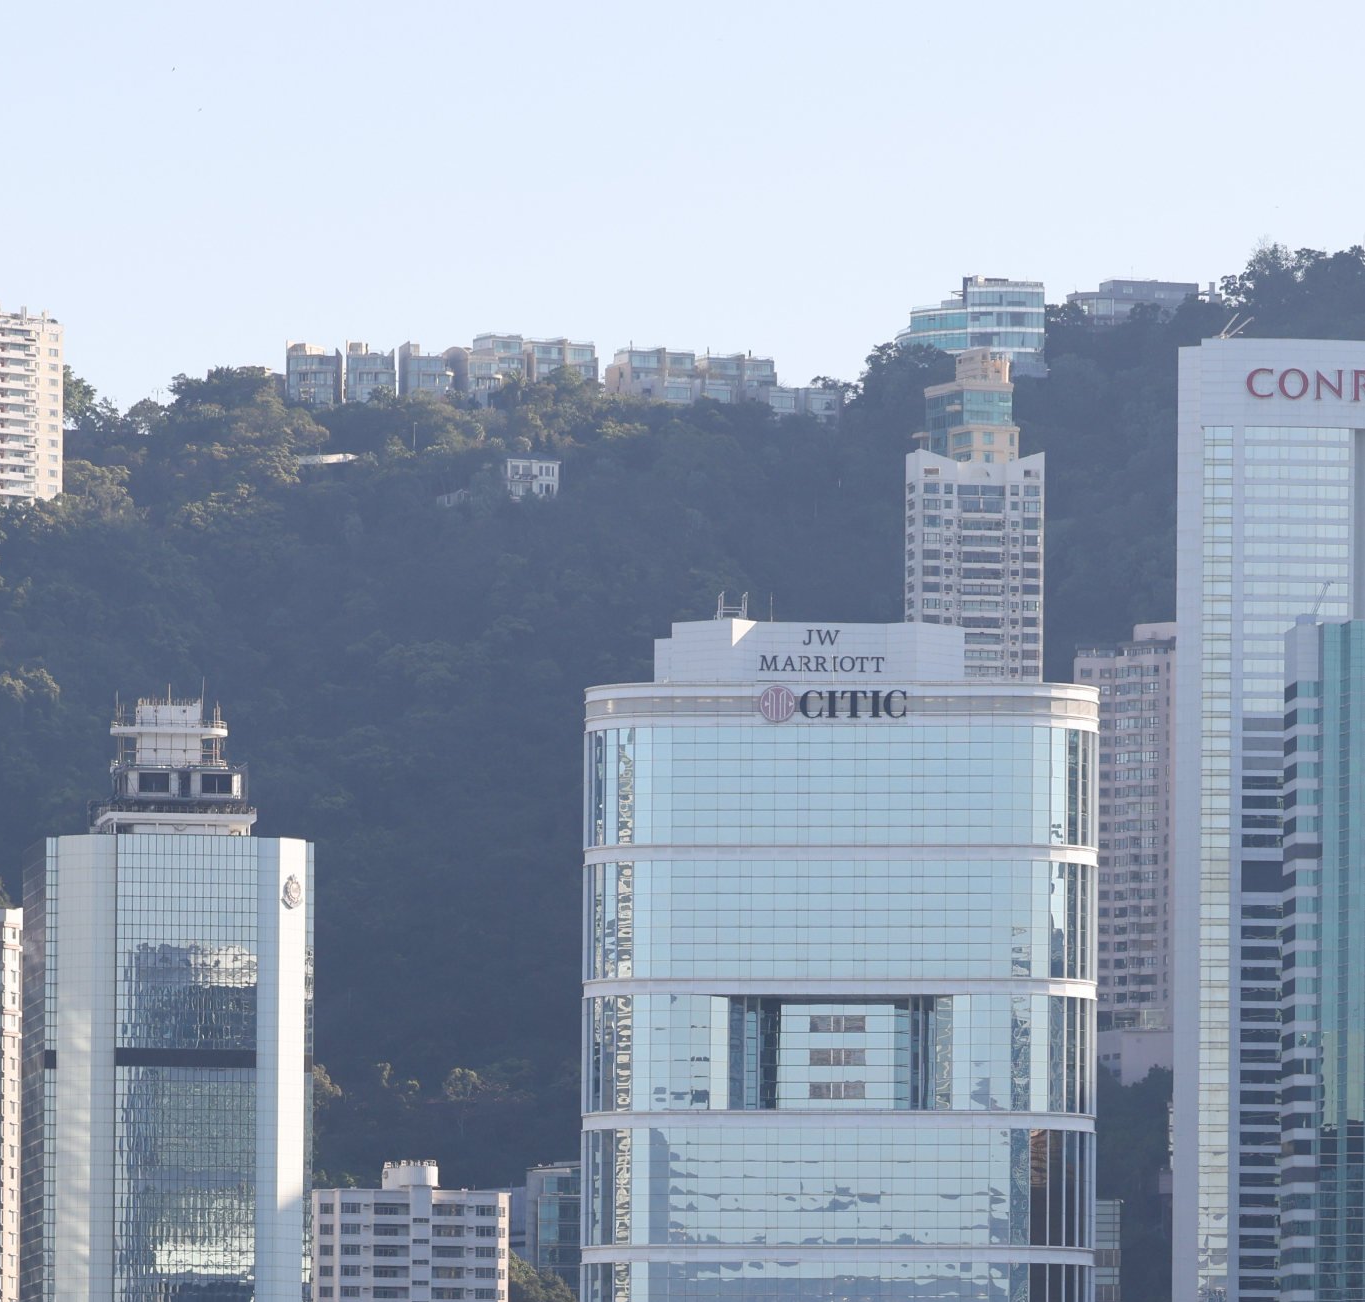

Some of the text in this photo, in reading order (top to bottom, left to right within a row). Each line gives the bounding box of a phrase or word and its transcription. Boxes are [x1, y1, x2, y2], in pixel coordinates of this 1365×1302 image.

[803, 629, 840, 646] JW
[758, 655, 885, 673] MARRIOTT
[800, 689, 907, 719] CITIC
